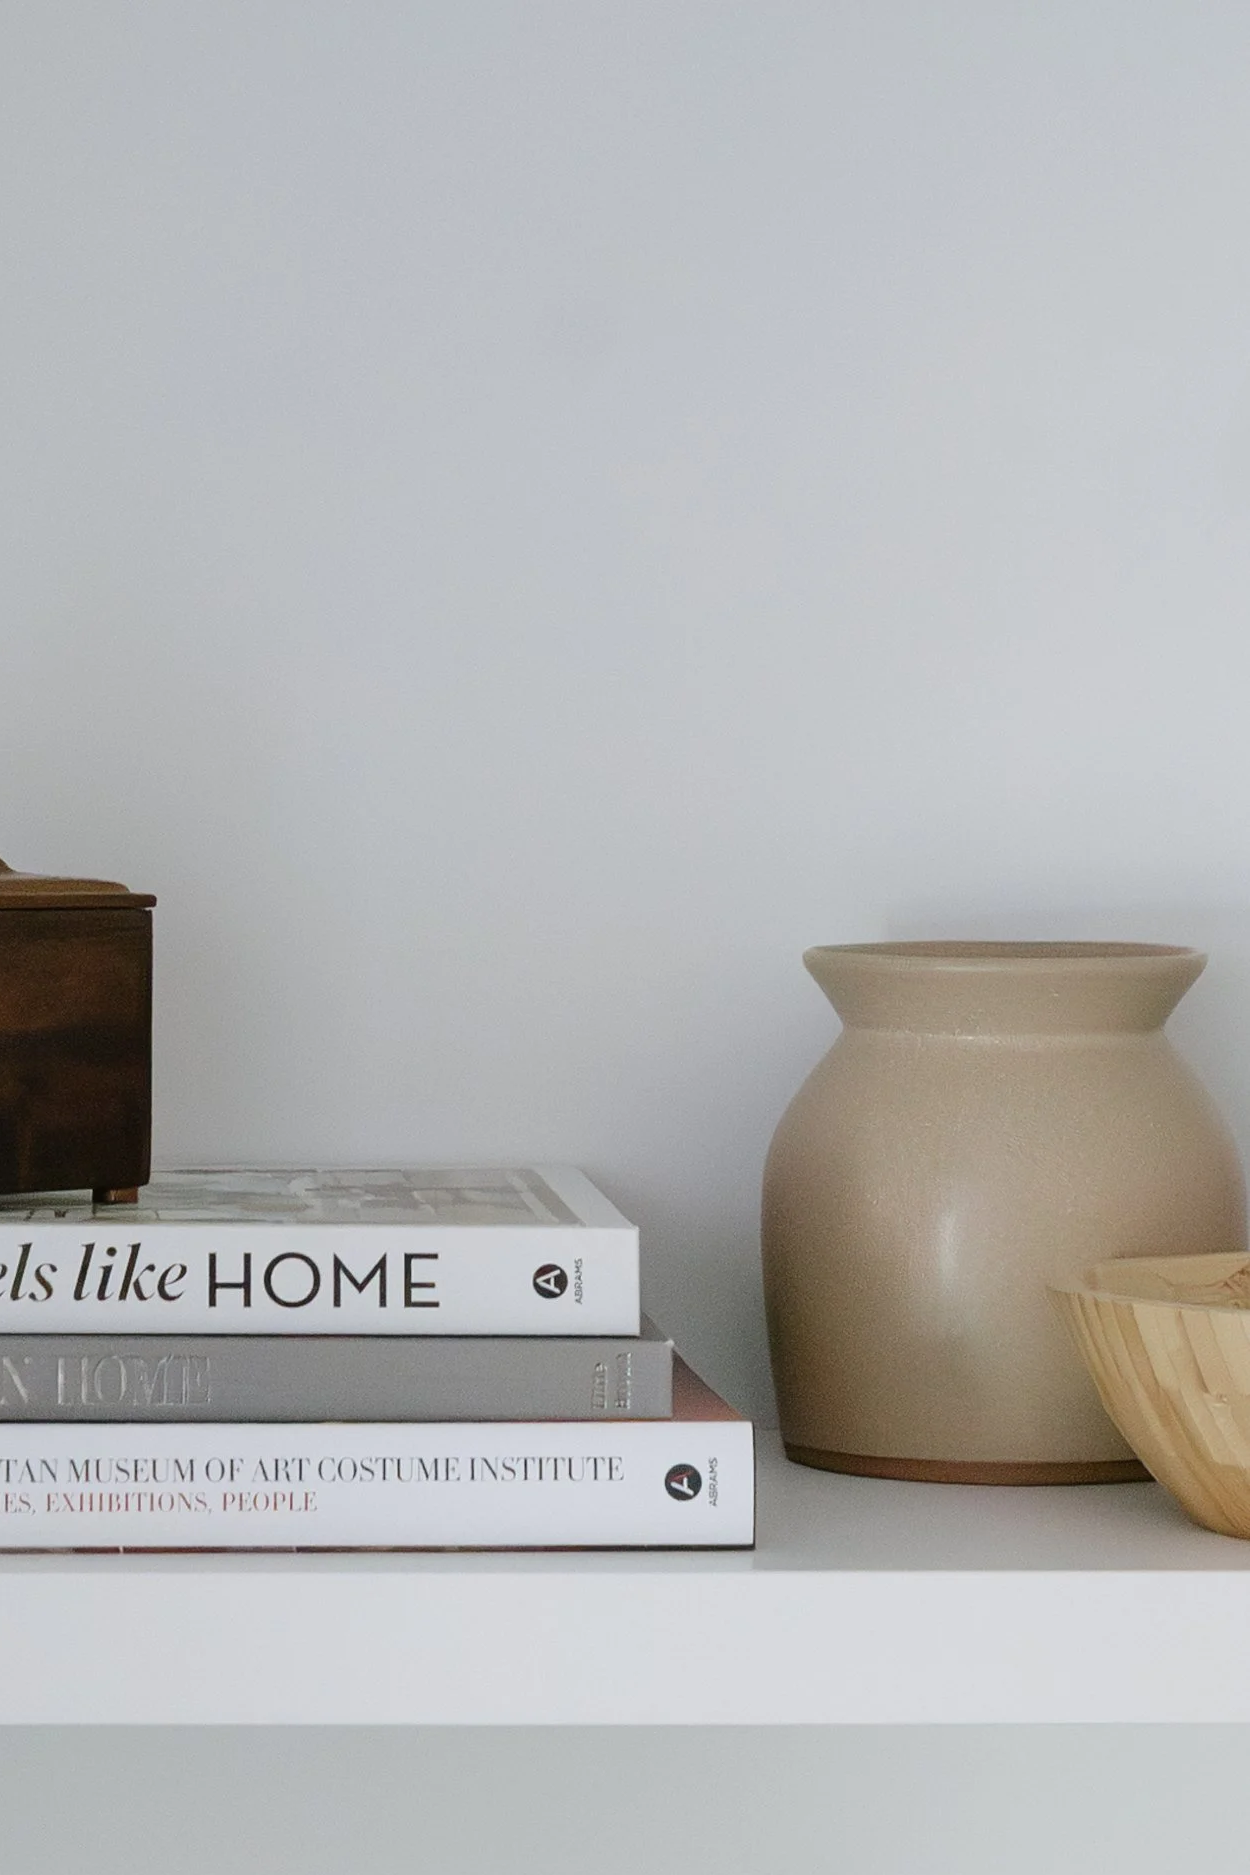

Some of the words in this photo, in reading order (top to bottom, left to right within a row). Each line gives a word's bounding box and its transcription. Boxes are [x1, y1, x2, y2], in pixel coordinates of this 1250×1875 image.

[72, 1241, 188, 1302] like
[207, 1251, 440, 1309] HOME
[573, 1258, 584, 1306] ABRAMS
[57, 1354, 212, 1405] HOME
[67, 1457, 196, 1484] MUSEUM
[204, 1456, 245, 1484] OF
[251, 1456, 311, 1484] ART
[316, 1456, 461, 1483] COSTUME
[468, 1456, 625, 1483] INSTITUTE
[707, 1457, 719, 1507] ABRAMS
[45, 1491, 213, 1515] EXHIBITIONS,
[221, 1491, 318, 1513] PEOPLE
